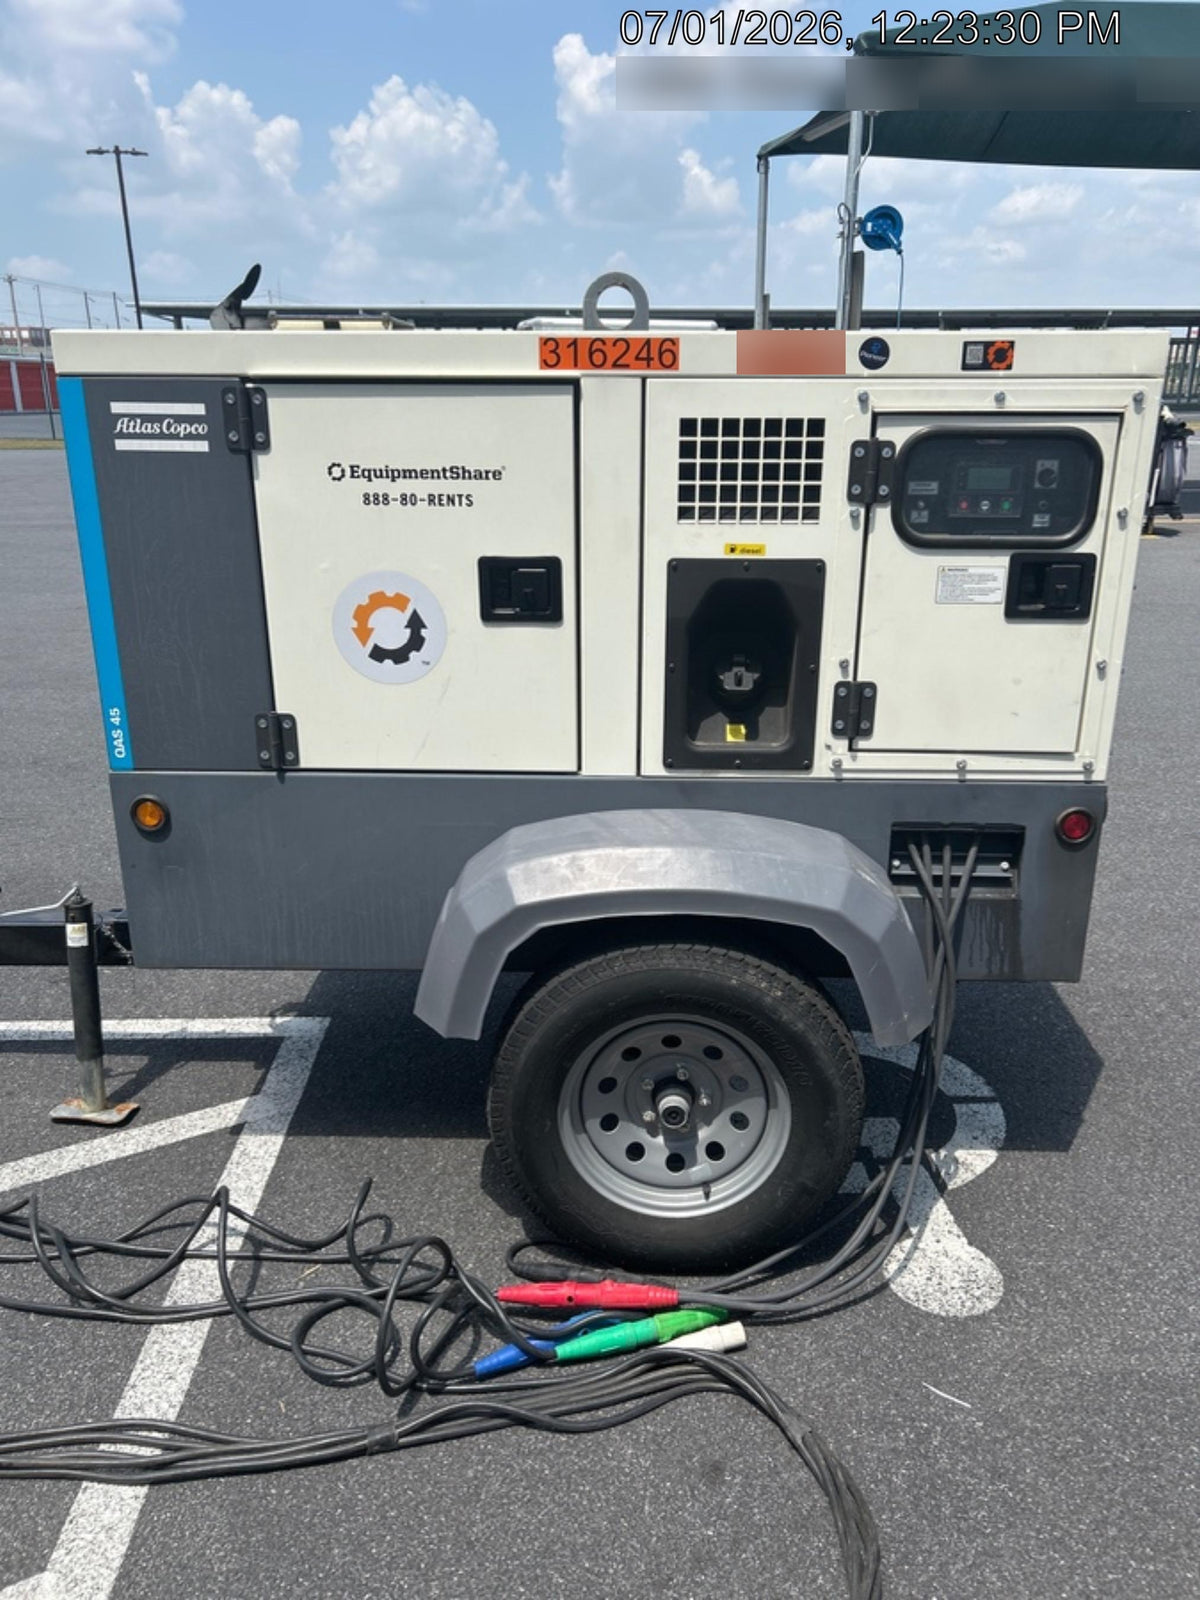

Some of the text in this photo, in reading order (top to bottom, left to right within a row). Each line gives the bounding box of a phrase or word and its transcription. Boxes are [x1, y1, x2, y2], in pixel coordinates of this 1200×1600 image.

[542, 337, 677, 369] 316246
[113, 417, 209, 438] Atlas Copco
[361, 491, 475, 508] 888-80-RENTS
[109, 706, 127, 759] QAS 45
